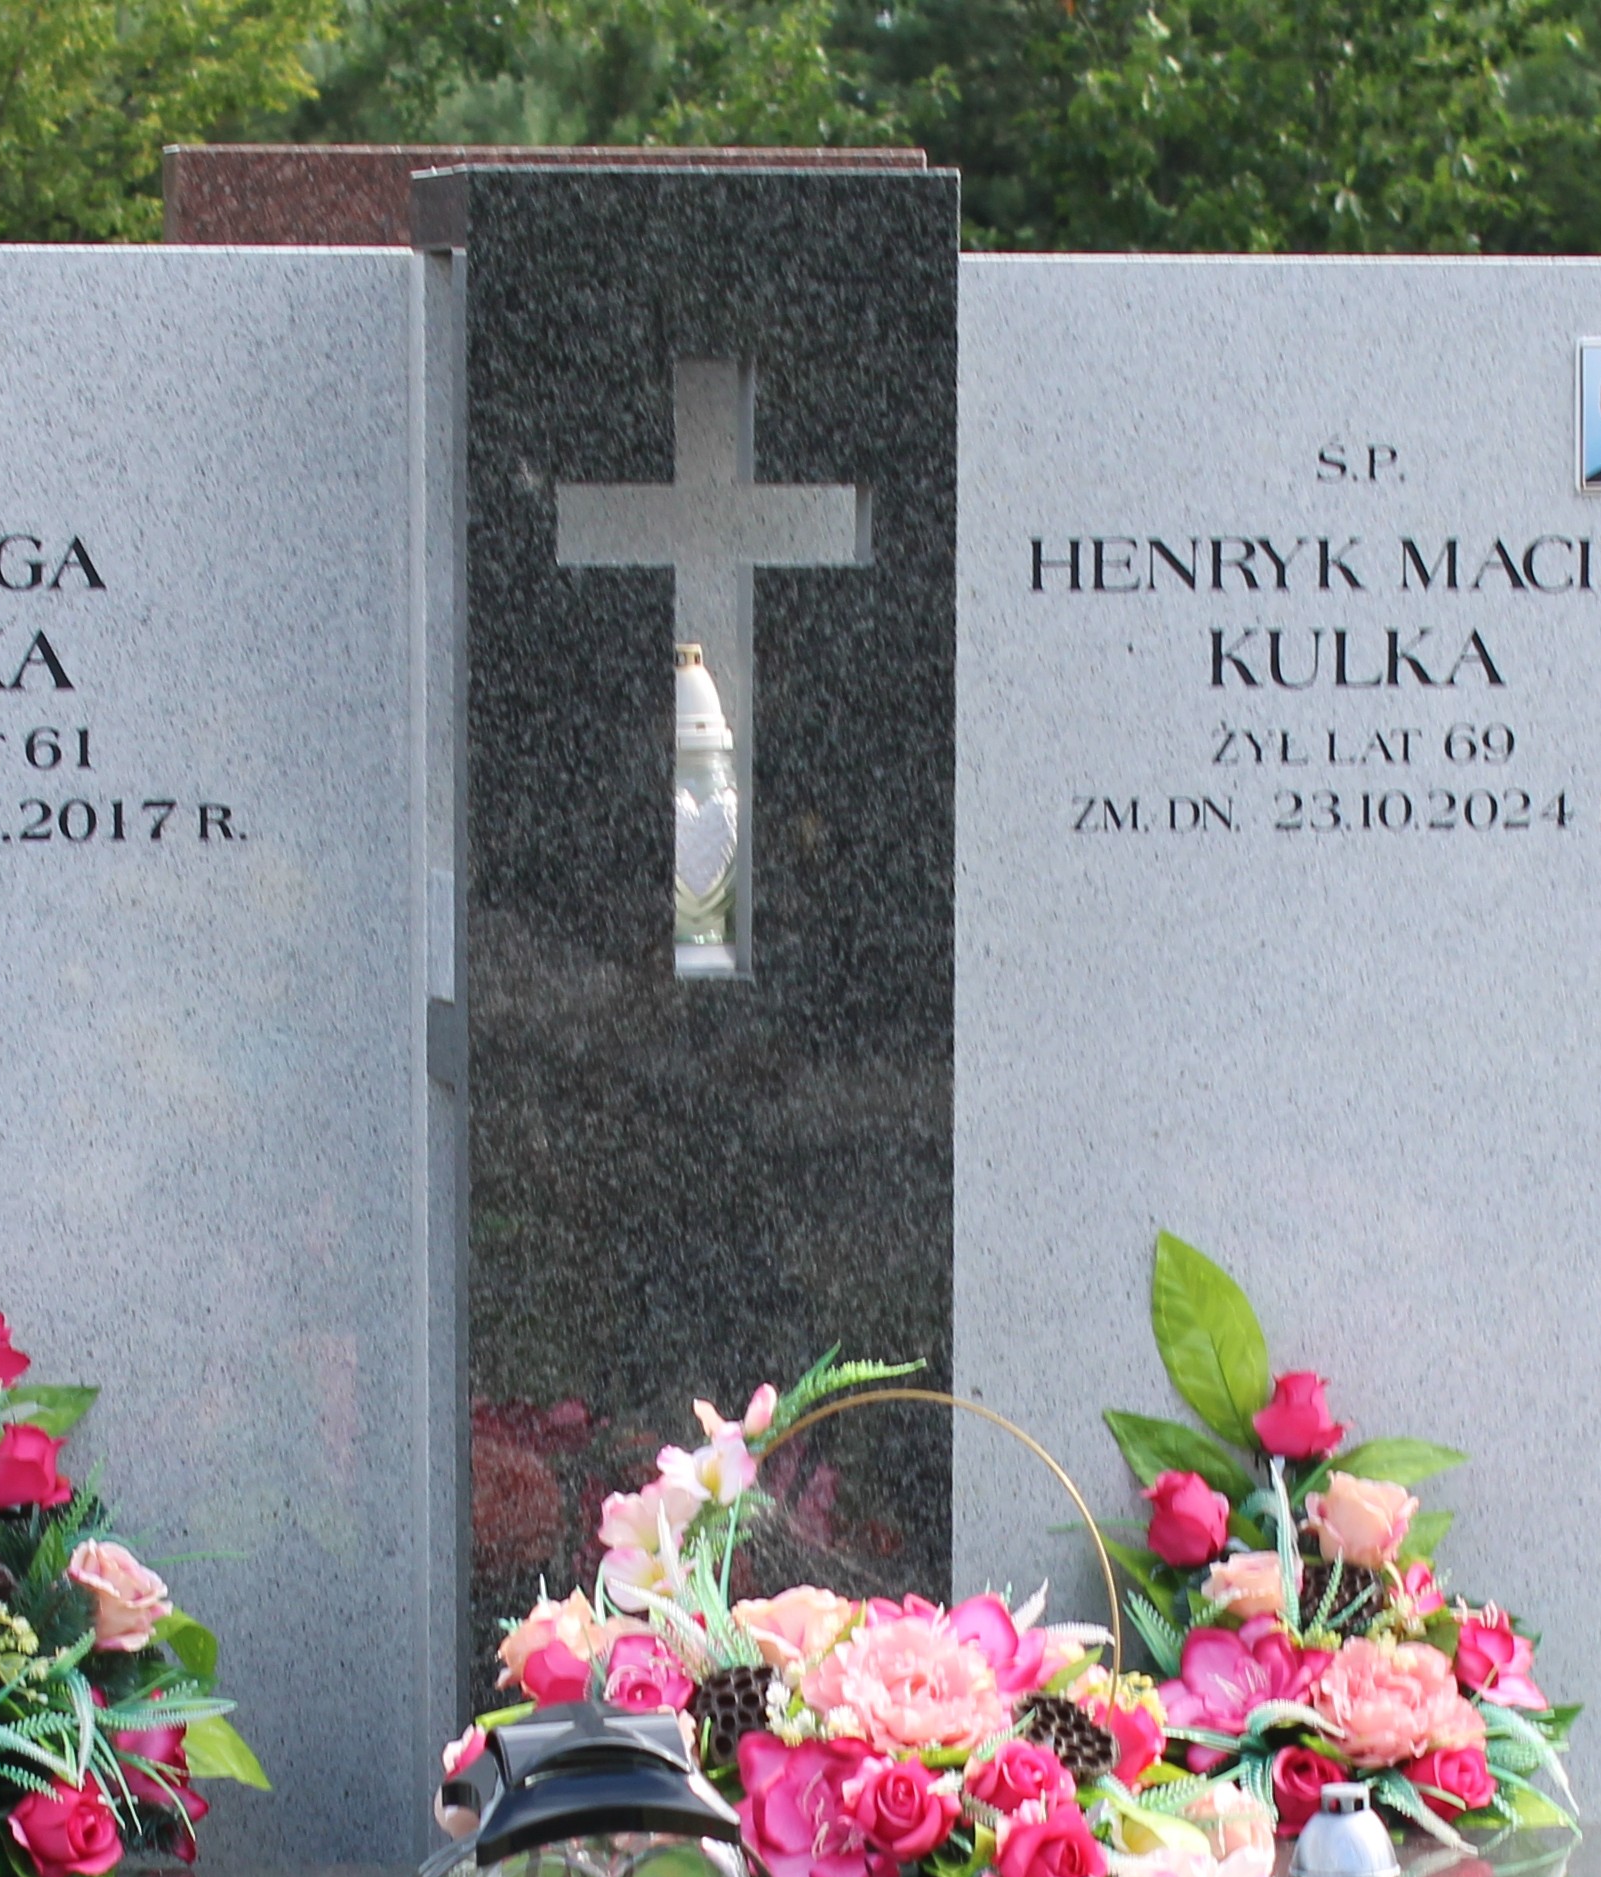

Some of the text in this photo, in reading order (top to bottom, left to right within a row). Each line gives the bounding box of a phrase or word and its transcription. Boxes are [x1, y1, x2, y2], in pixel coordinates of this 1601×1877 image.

[1317, 443, 1406, 483] Ś.P.
[1031, 537, 1363, 592] HENRYK
[1210, 628, 1506, 689] KULKA
[24, 728, 92, 769] 61
[1212, 721, 1517, 766] ŻYŁ LAT 69
[198, 803, 248, 844] R.
[1072, 796, 1151, 831] ZM.
[1168, 796, 1242, 831] DN.
[1273, 787, 1572, 832] 23.10.2024
